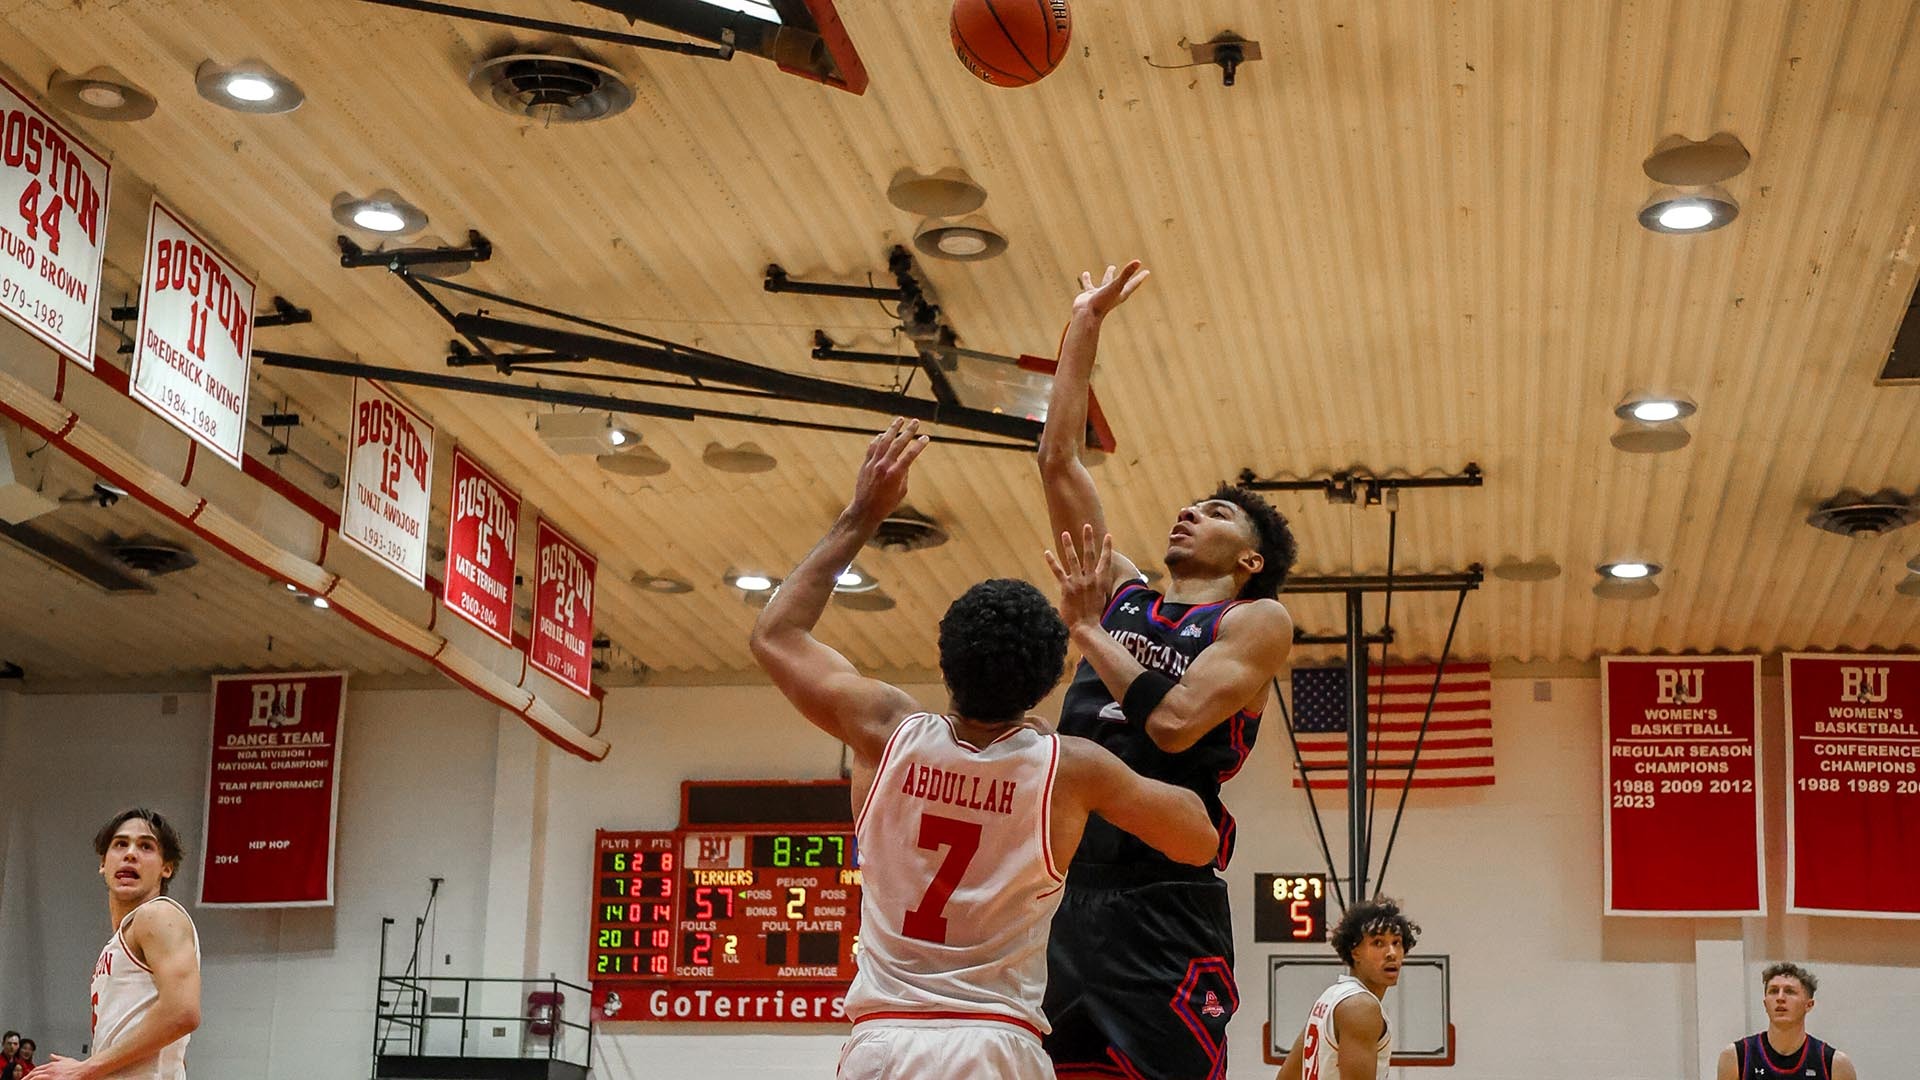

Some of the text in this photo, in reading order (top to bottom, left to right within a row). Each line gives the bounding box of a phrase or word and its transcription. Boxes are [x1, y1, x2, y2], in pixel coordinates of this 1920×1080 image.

[19, 179, 63, 256] 44
[40, 255, 88, 305] BROWN
[155, 239, 247, 360] BOSTON
[187, 300, 207, 362] 11
[146, 328, 240, 415] DREDERICK IRVING
[162, 385, 217, 437] 1984-1988
[357, 399, 428, 493] BOSTON
[380, 448, 401, 502] 12
[358, 483, 420, 539] TUNJI AWOJOBI
[457, 476, 515, 560] BOSTON
[476, 520, 491, 568] 15
[456, 553, 508, 604] KATIE TERHUNE
[541, 543, 591, 616] BOSTON
[461, 592, 497, 628] 2000-2004
[554, 581, 575, 628] 24
[1656, 669, 1704, 704] BU
[1840, 667, 1890, 703] BU
[249, 683, 306, 727] BU
[1828, 707, 1903, 720] WOMEN'S
[1645, 709, 1717, 720] WOMEN'S
[1631, 724, 1732, 735] BASKETBALL
[1815, 722, 1919, 735] BASKETBALL
[227, 731, 325, 746] DANCE TEAM
[261, 749, 305, 759] DIVISION
[1612, 745, 1752, 757] REGULAR SEASON
[1814, 744, 1920, 757] CONFERENCE
[217, 762, 268, 771] NATIONAL
[1635, 762, 1728, 773] CHAMPIONS
[1820, 760, 1916, 773] CHAMPIONS
[219, 780, 324, 790] TEAM PERFORMANCE
[902, 762, 1016, 814] ABDULLAH
[1613, 780, 1752, 793] 1988 2009 2012
[1798, 778, 1840, 792] 1988
[1848, 779, 1890, 793] 1989
[1613, 795, 1655, 808] 2023
[249, 840, 290, 849] HIP HOP
[601, 839, 672, 849] PLYR F PTS
[773, 837, 844, 867] 8:27
[215, 855, 239, 864] 2014
[614, 853, 673, 872] 6 2 8
[693, 870, 753, 885] TERRIERS
[776, 877, 818, 888] PERIOD
[901, 813, 983, 944] 7
[616, 879, 671, 897] 7 2 3
[746, 890, 772, 900] POSS
[820, 890, 847, 900] POSS
[1273, 878, 1322, 900] 8:27
[605, 903, 671, 921] 14 0 14
[696, 888, 733, 919] 57
[746, 906, 777, 916] BONUS
[786, 887, 806, 919] 2
[814, 906, 846, 917] BONUS
[681, 921, 716, 931] FOULS
[762, 921, 842, 931] FOUL PLAYER
[1291, 900, 1313, 938] 5
[598, 930, 669, 948] 20 1 10
[724, 935, 738, 955] 2
[692, 933, 711, 964] 2
[597, 955, 669, 974] 21 1 10
[722, 954, 739, 963] TOL
[676, 967, 714, 977] SCORE
[777, 967, 838, 977] ADVANTAGE
[650, 990, 846, 1018] GoTerriers
